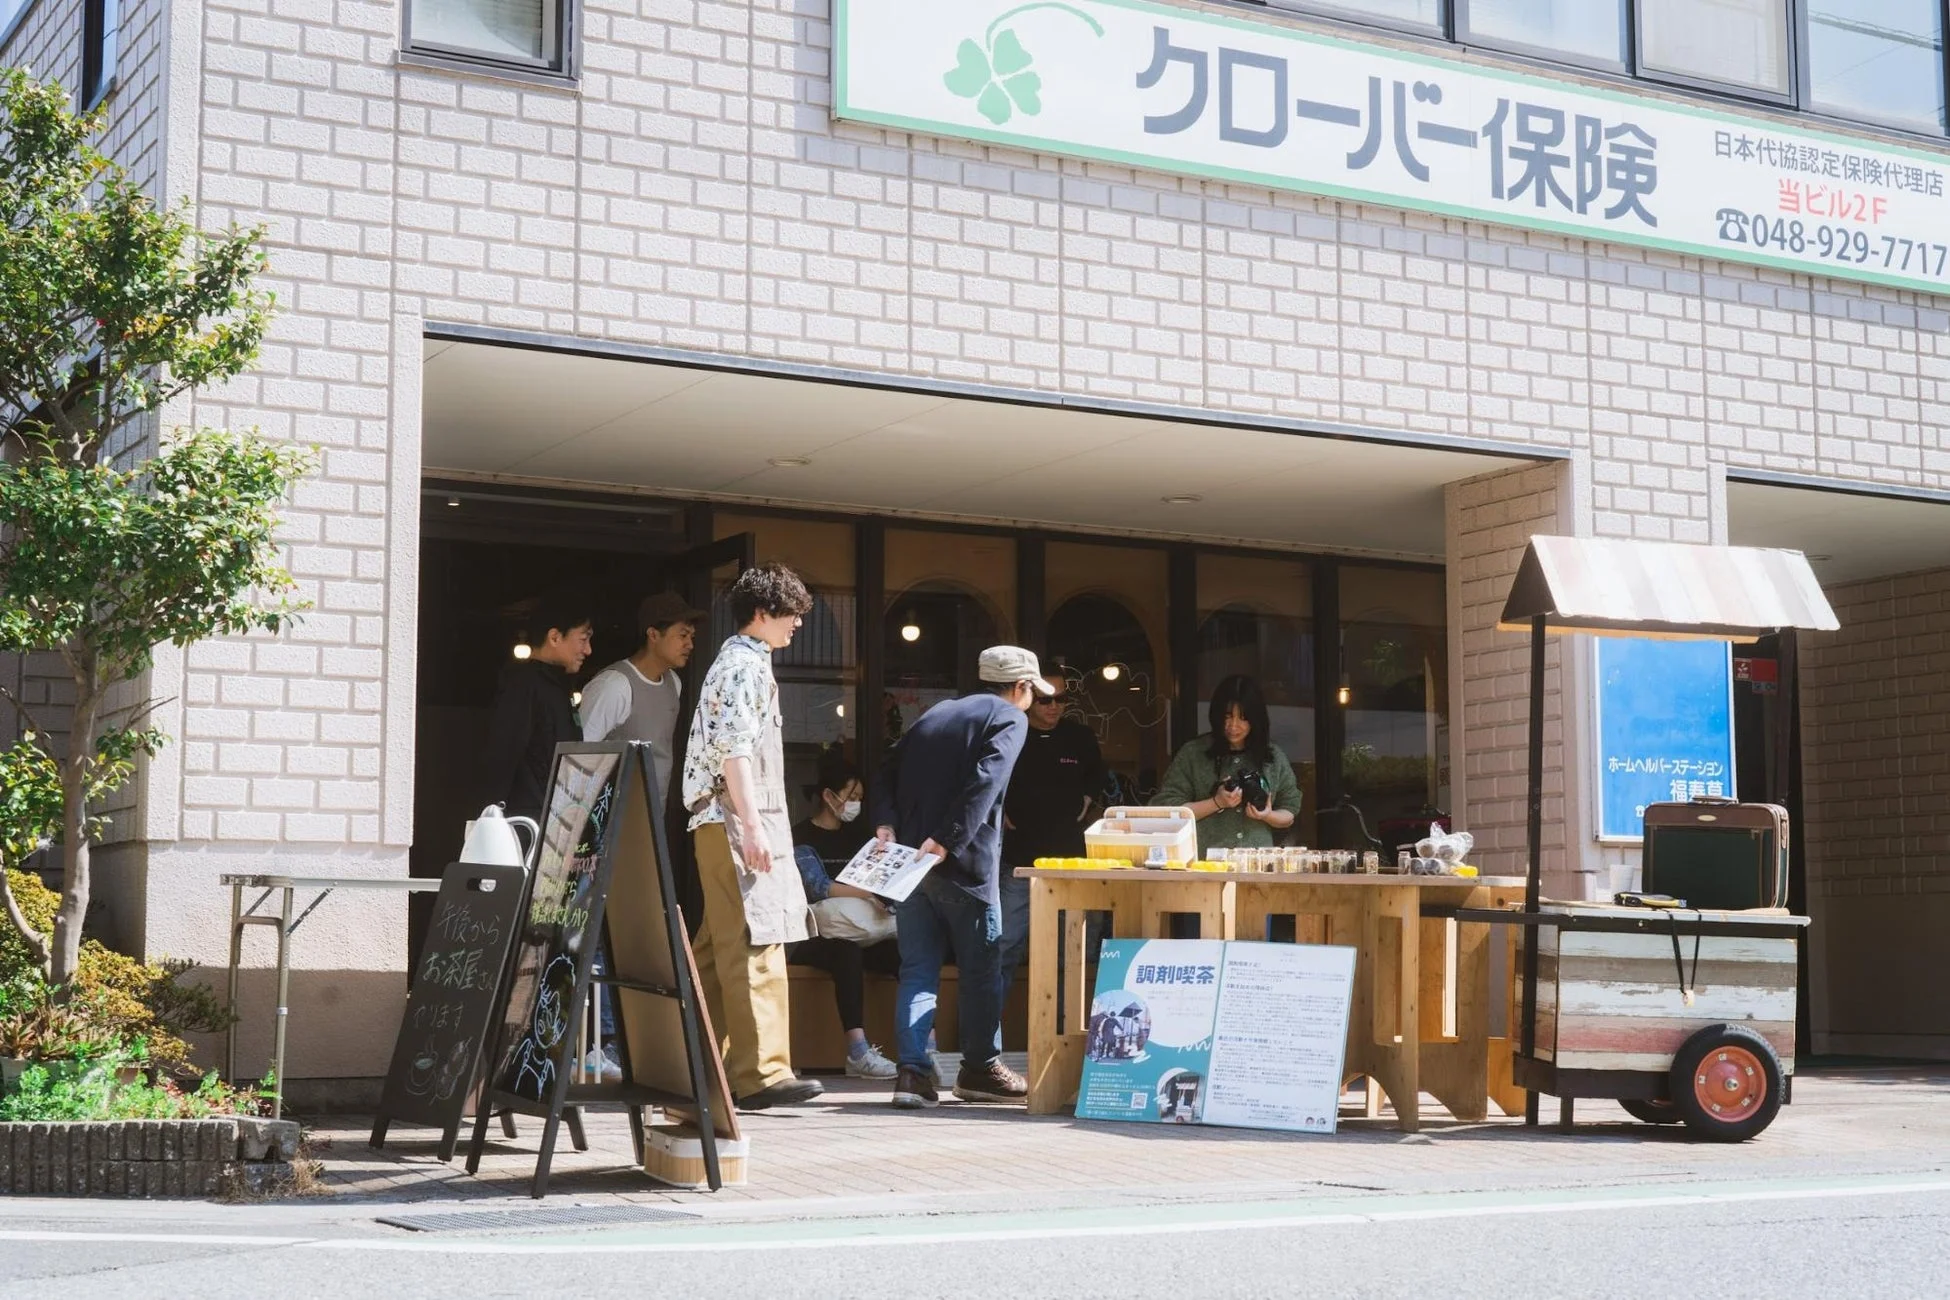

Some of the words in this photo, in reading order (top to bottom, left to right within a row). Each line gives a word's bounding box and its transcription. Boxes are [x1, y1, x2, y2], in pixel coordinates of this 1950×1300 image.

[1136, 26, 1659, 229] クローバー保険
[1714, 130, 1943, 197] 日本代協認定保険代理店
[1752, 213, 1948, 277] 048-929-7717
[1608, 757, 1723, 777] ホームヘルパーステーション
[437, 901, 501, 945] 午後から
[1136, 965, 1215, 985] 調剤喫茶
[414, 1001, 464, 1032] やります
